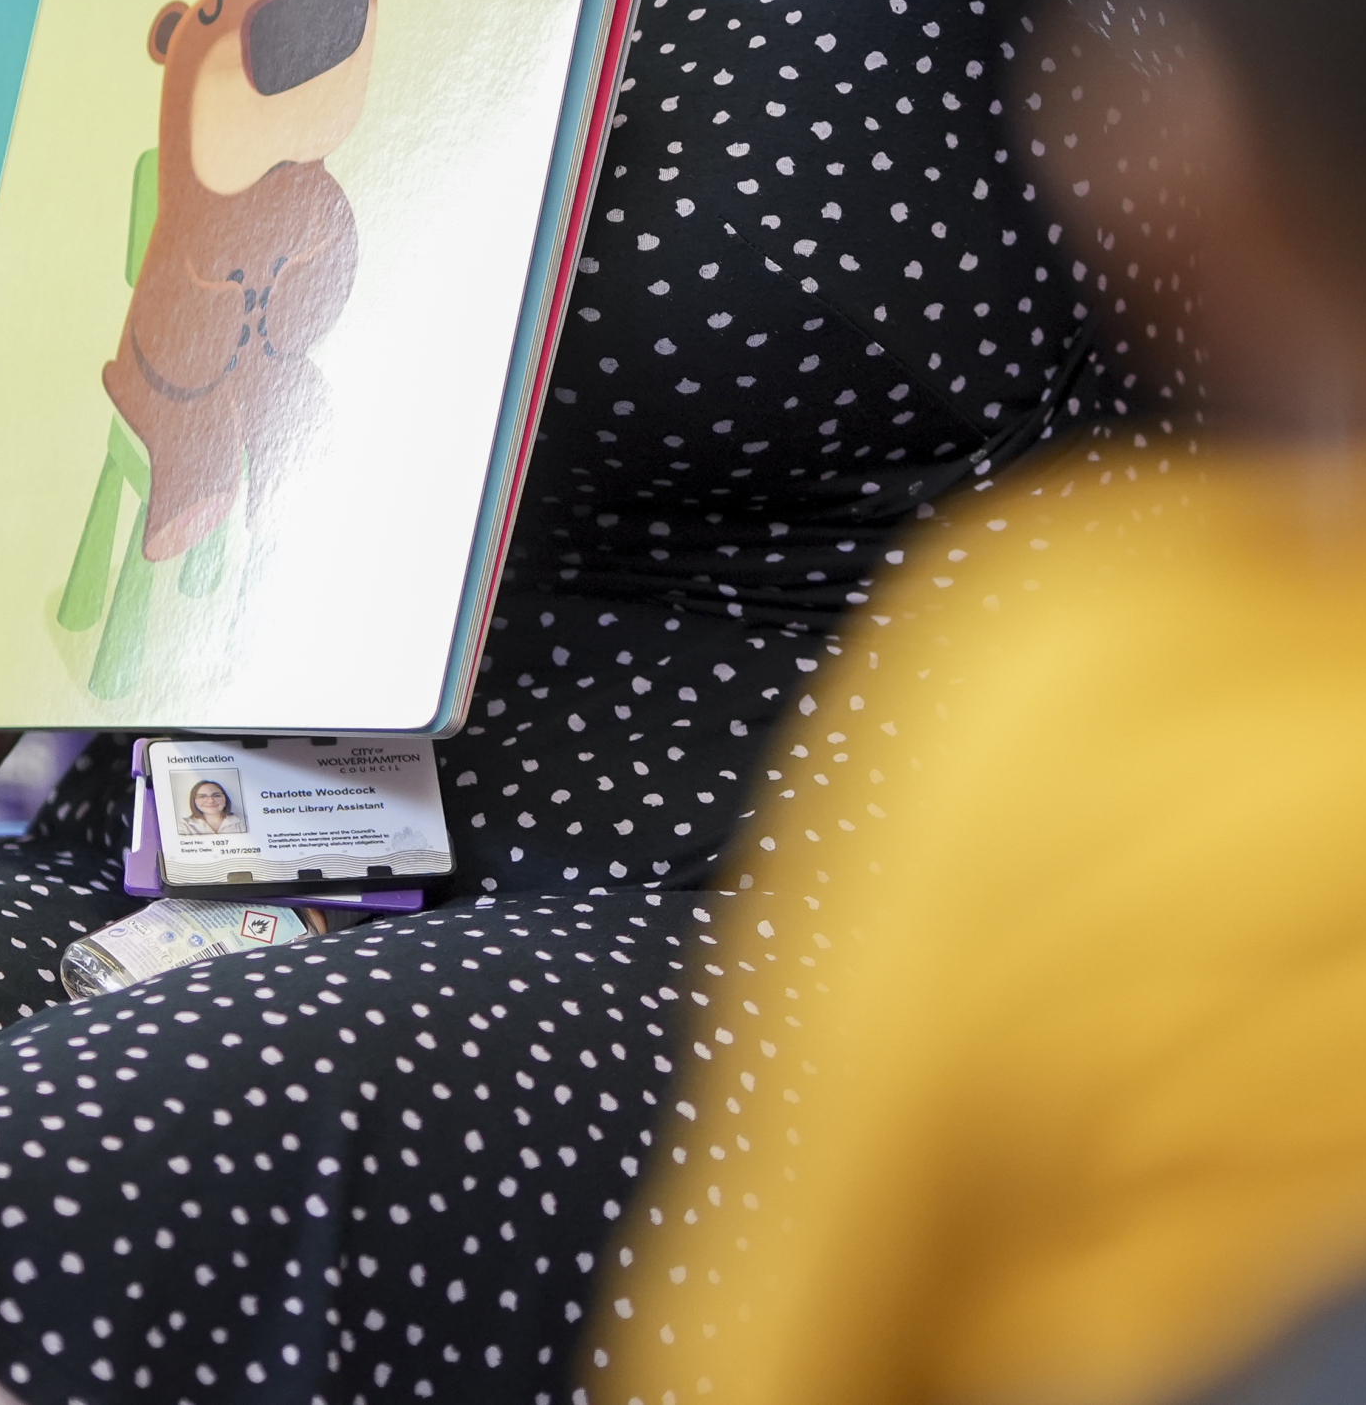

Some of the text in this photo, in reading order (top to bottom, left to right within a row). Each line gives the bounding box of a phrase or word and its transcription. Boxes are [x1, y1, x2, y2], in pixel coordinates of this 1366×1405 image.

[351, 747, 374, 756] CITY
[167, 753, 235, 764] Identification
[317, 753, 421, 767] WOLVERHAMPTON
[339, 765, 401, 774] COUNCIL
[260, 786, 377, 799] Charlotte Woodcock
[262, 801, 385, 815] Senior Library Assistant
[220, 847, 262, 855] 31/07/2028
